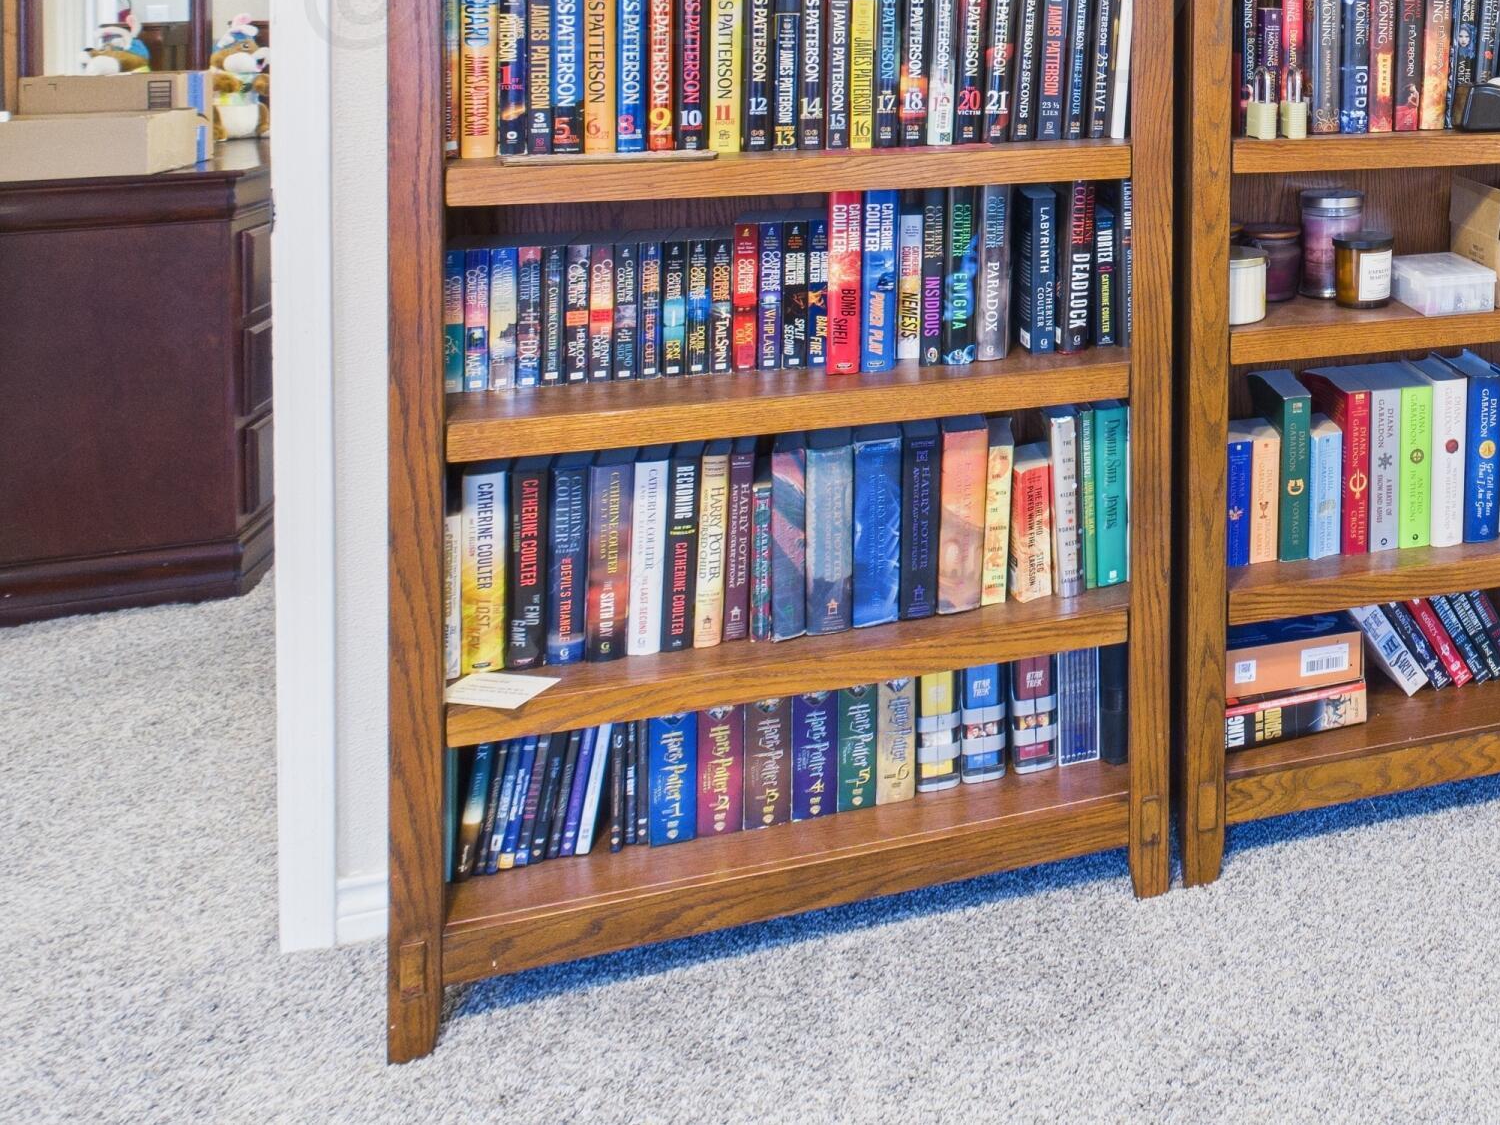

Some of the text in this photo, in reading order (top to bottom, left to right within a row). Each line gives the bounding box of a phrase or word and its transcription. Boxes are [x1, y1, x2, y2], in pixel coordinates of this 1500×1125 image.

[752, 8, 767, 82] PATTERSON
[1355, 1, 1366, 45] MONING
[531, 4, 550, 109] JAMES PATTERSON
[557, 14, 576, 107] PATTERSON
[623, 14, 638, 104] PATTERSON
[717, 13, 733, 99] PATTERSON
[1044, 5, 1062, 95] JAMES PATTERSON
[1246, 38, 1256, 80] BLOODFEVER
[1407, 25, 1416, 77] FEVERBORN
[463, 54, 490, 136] JAMES PATTERSON
[748, 98, 767, 110] 12
[1019, 59, 1031, 119] 22 SECONDS
[1355, 65, 1368, 108] ICED
[865, 204, 880, 251] COULTER
[880, 203, 894, 251] CATHERINE
[1039, 207, 1050, 273] LABYRINTH
[1097, 229, 1113, 263] VORTEX
[841, 289, 856, 316] BOMB
[901, 292, 918, 339] NEMESIS
[924, 276, 940, 336] INSIDIOUS
[952, 272, 967, 330] ENIGMA
[985, 261, 1000, 332] PARADOX
[1069, 253, 1091, 329] DEADLOCK
[575, 328, 585, 368] HEMLOCK
[763, 308, 776, 358] WHIPLASH
[784, 324, 793, 355] SECOND
[794, 318, 805, 340] SPLIT
[832, 317, 848, 346] SHELL
[868, 291, 884, 355] POWER PLAY
[519, 340, 538, 368] EDGE
[568, 341, 577, 357] BAY
[1480, 388, 1489, 438] GABALDON
[1489, 398, 1497, 428] DIANA
[673, 465, 695, 519] RECKONING
[520, 479, 540, 587] CATHERINE COULTER
[707, 486, 726, 583] HARRY POTTER
[1291, 501, 1300, 546] VOYAGER
[1028, 555, 1036, 586] LARSSON
[1035, 552, 1044, 573] STIEG
[558, 564, 572, 643] DEVIL'S TRIANGLE
[671, 542, 688, 635] CATHERINE COULTER
[510, 619, 526, 648] GAME
[524, 605, 539, 626] END
[1389, 649, 1417, 681] SERUM
[800, 710, 830, 778] Harry Potter
[1228, 715, 1245, 748] KING
[1264, 707, 1282, 740] STAND
[660, 730, 688, 800] Harry Potter
[709, 725, 735, 793] Harry Potter
[752, 718, 784, 786] Harry Potter
